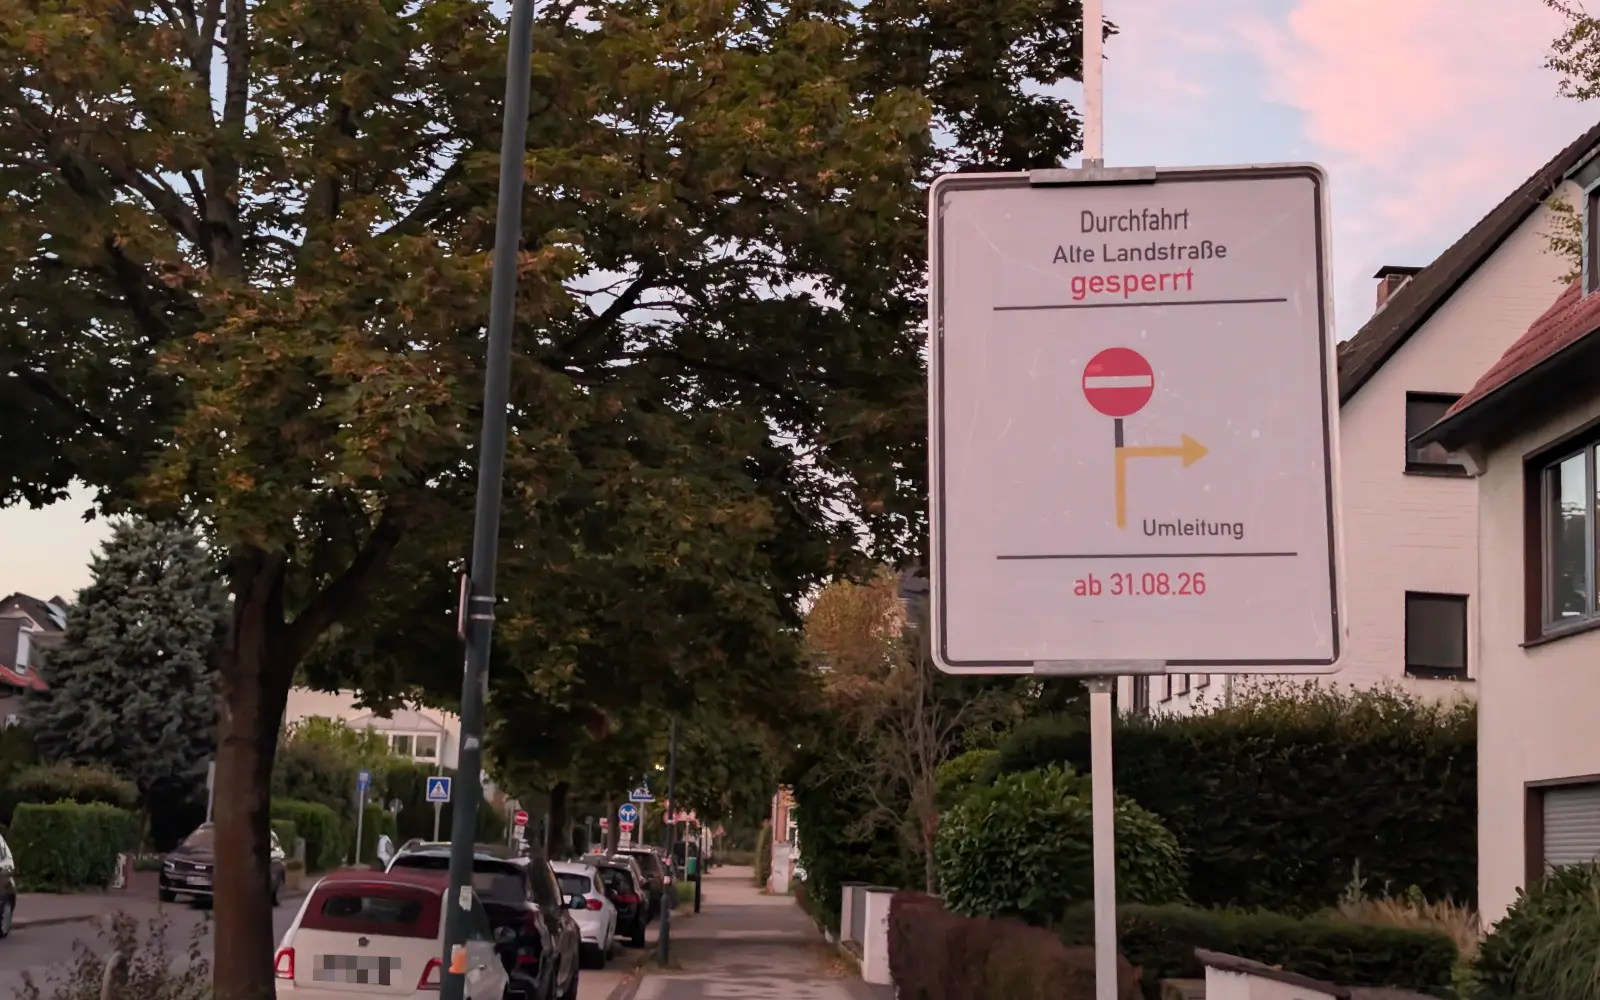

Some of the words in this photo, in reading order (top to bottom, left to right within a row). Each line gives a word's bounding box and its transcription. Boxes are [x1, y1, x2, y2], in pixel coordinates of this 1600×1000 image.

[1081, 208, 1189, 233] Durchfahrt
[1053, 245, 1095, 264] Alte
[1103, 240, 1226, 262] Landstraße
[1071, 268, 1193, 300] gesperrt
[1143, 519, 1244, 540] Umleitung
[1074, 573, 1101, 596] ab
[1110, 572, 1206, 595] 31.08.26
